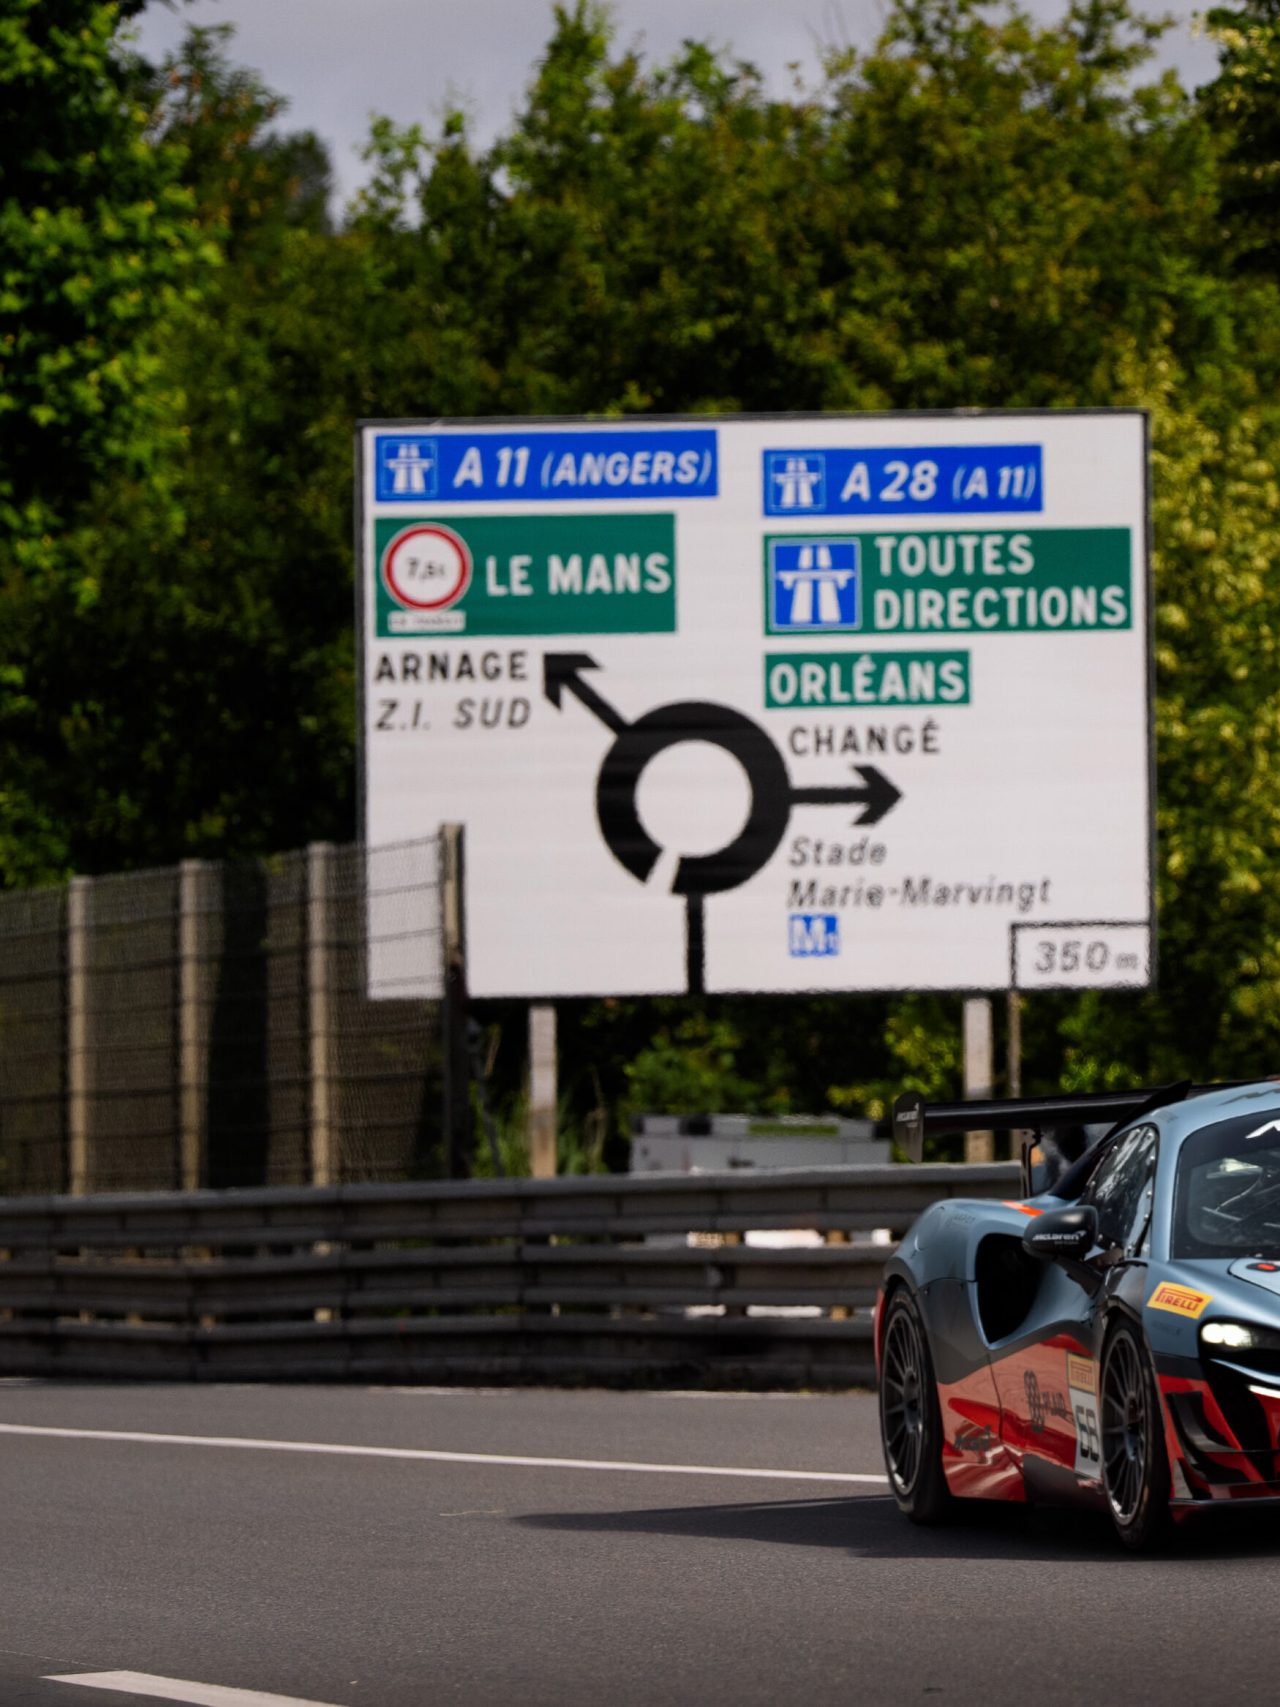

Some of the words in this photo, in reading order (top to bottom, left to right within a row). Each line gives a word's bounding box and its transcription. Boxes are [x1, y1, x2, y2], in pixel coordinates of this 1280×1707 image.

[453, 447, 483, 487] A
[496, 447, 530, 487] 11
[541, 449, 712, 488] (ANGERS)
[841, 462, 871, 501] A
[879, 460, 938, 501] 28
[952, 464, 989, 503] (A
[999, 464, 1036, 502] 11)
[486, 555, 533, 596] LE
[548, 553, 671, 595] MANS
[874, 533, 1034, 577] TOUTES
[873, 585, 1128, 630] DIRECTIONS
[375, 651, 528, 683] ARNAGE
[769, 654, 966, 704] ORLÉANS
[375, 698, 431, 731] Z.I.
[453, 698, 531, 729] SUD
[788, 716, 941, 756] CHANGÉ
[788, 836, 887, 867] Stade
[787, 876, 1051, 913] Marie-Marvingt
[1034, 941, 1110, 973] 350
[1115, 951, 1139, 970] m
[1155, 1288, 1203, 1311] PIRELLI
